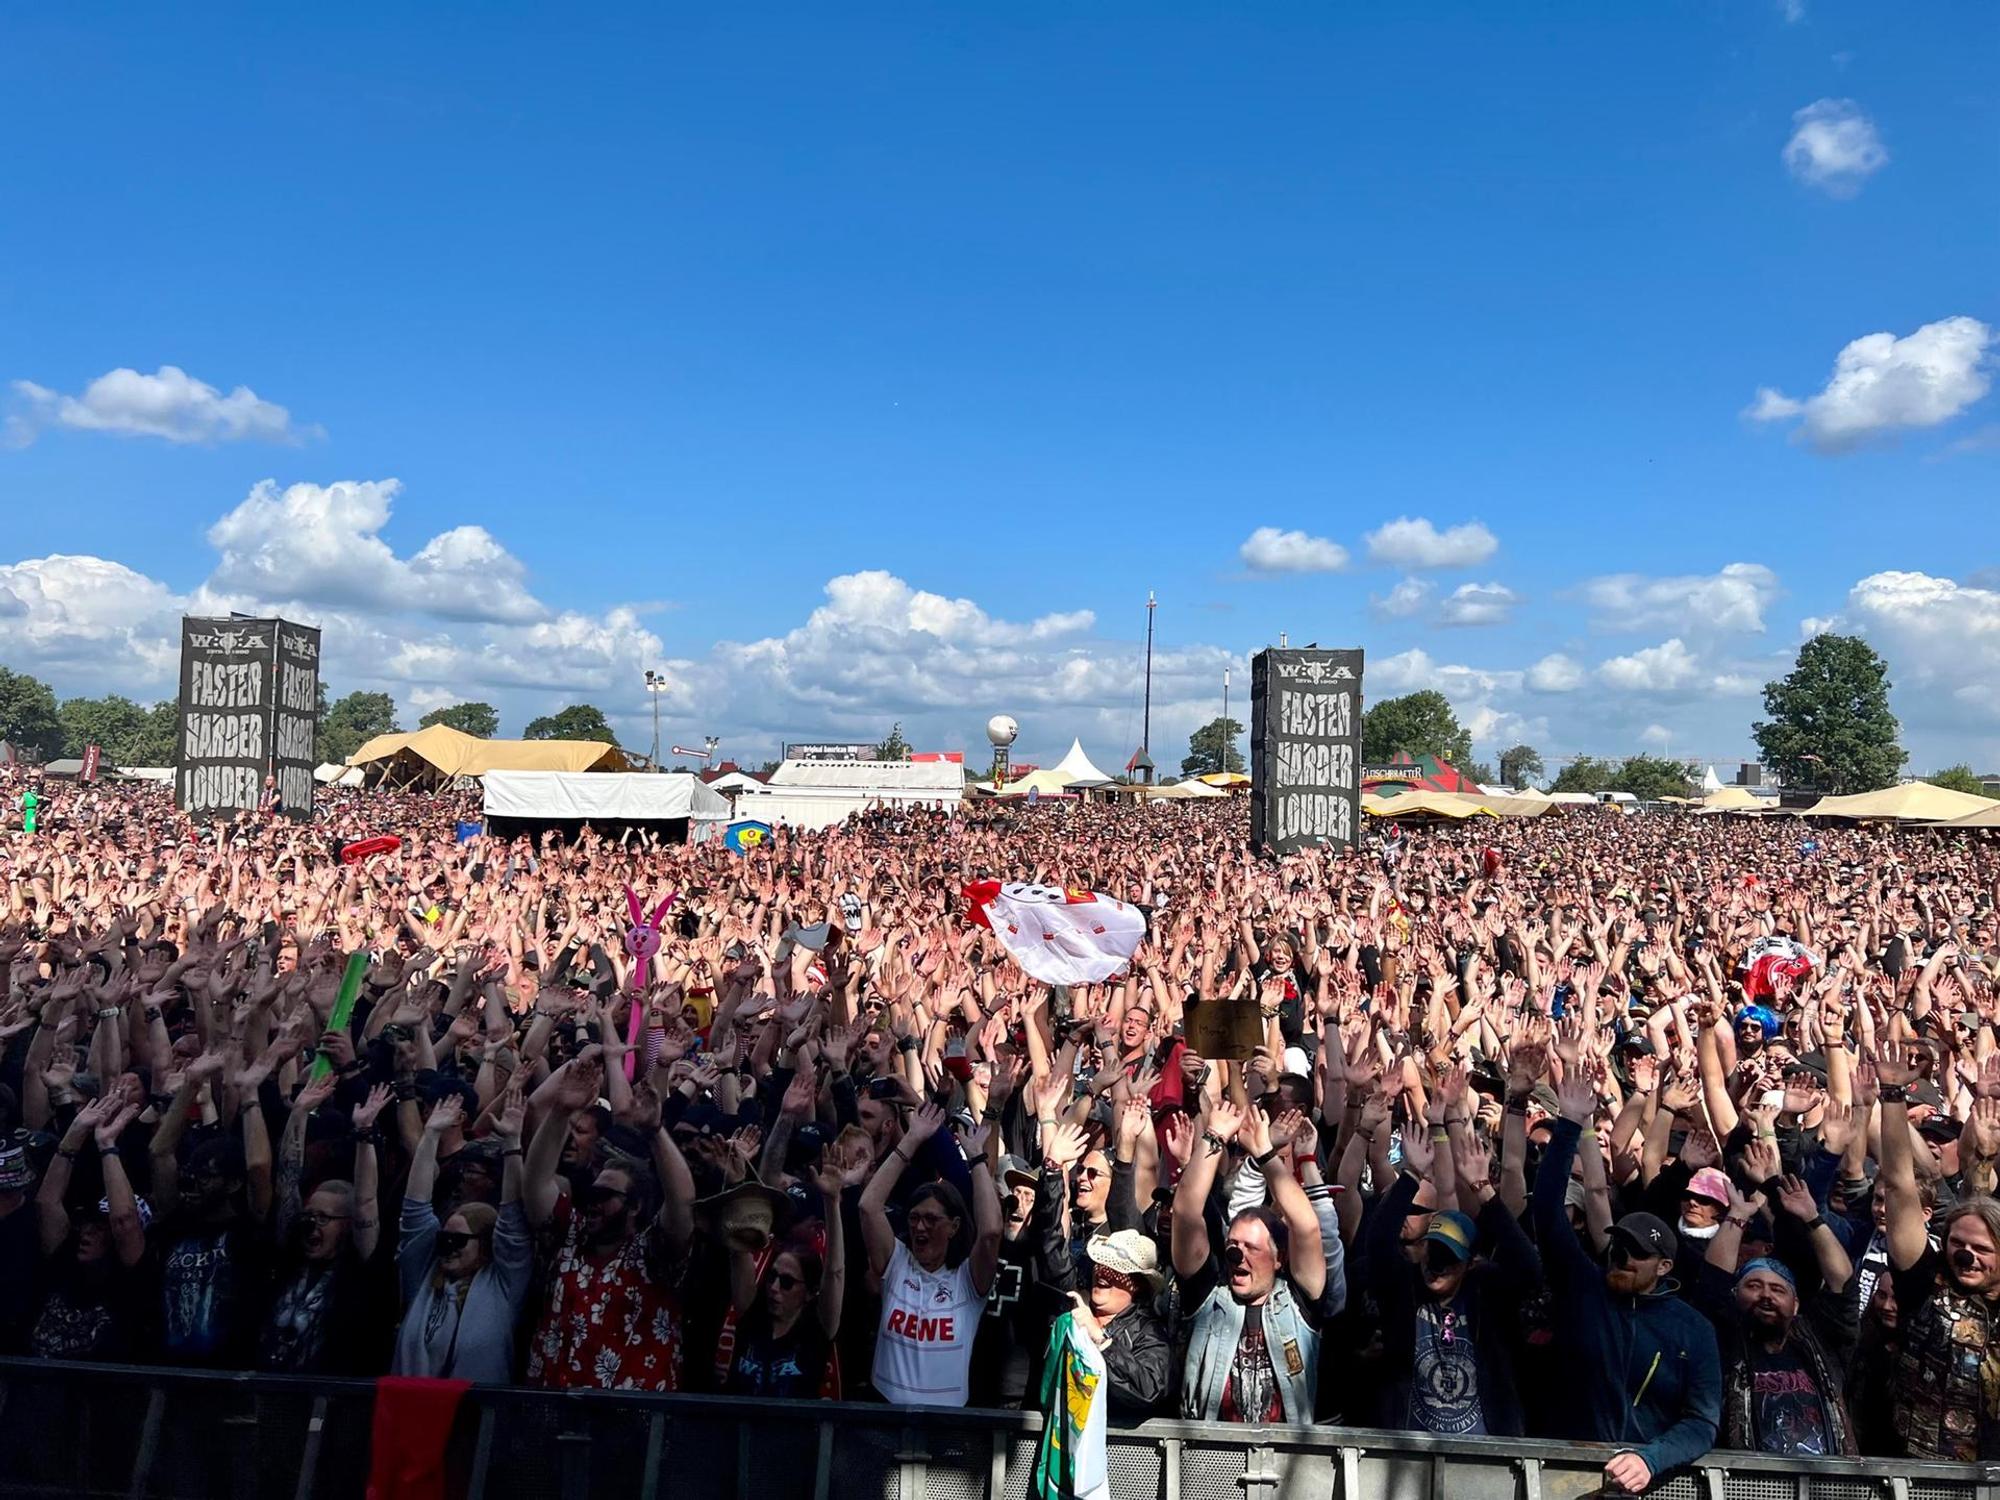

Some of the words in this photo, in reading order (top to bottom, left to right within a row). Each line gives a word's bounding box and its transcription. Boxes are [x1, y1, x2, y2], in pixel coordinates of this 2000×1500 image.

[191, 660, 263, 708] FASTER
[282, 661, 315, 712] FASTER
[185, 713, 263, 761] HARDER
[276, 713, 314, 763] HARDER
[1281, 690, 1351, 737] FASTER
[184, 764, 259, 813] LOUDER
[1276, 741, 1353, 790] HARDER
[1277, 793, 1351, 842] LOUDER
[887, 1307, 955, 1342] REWE
